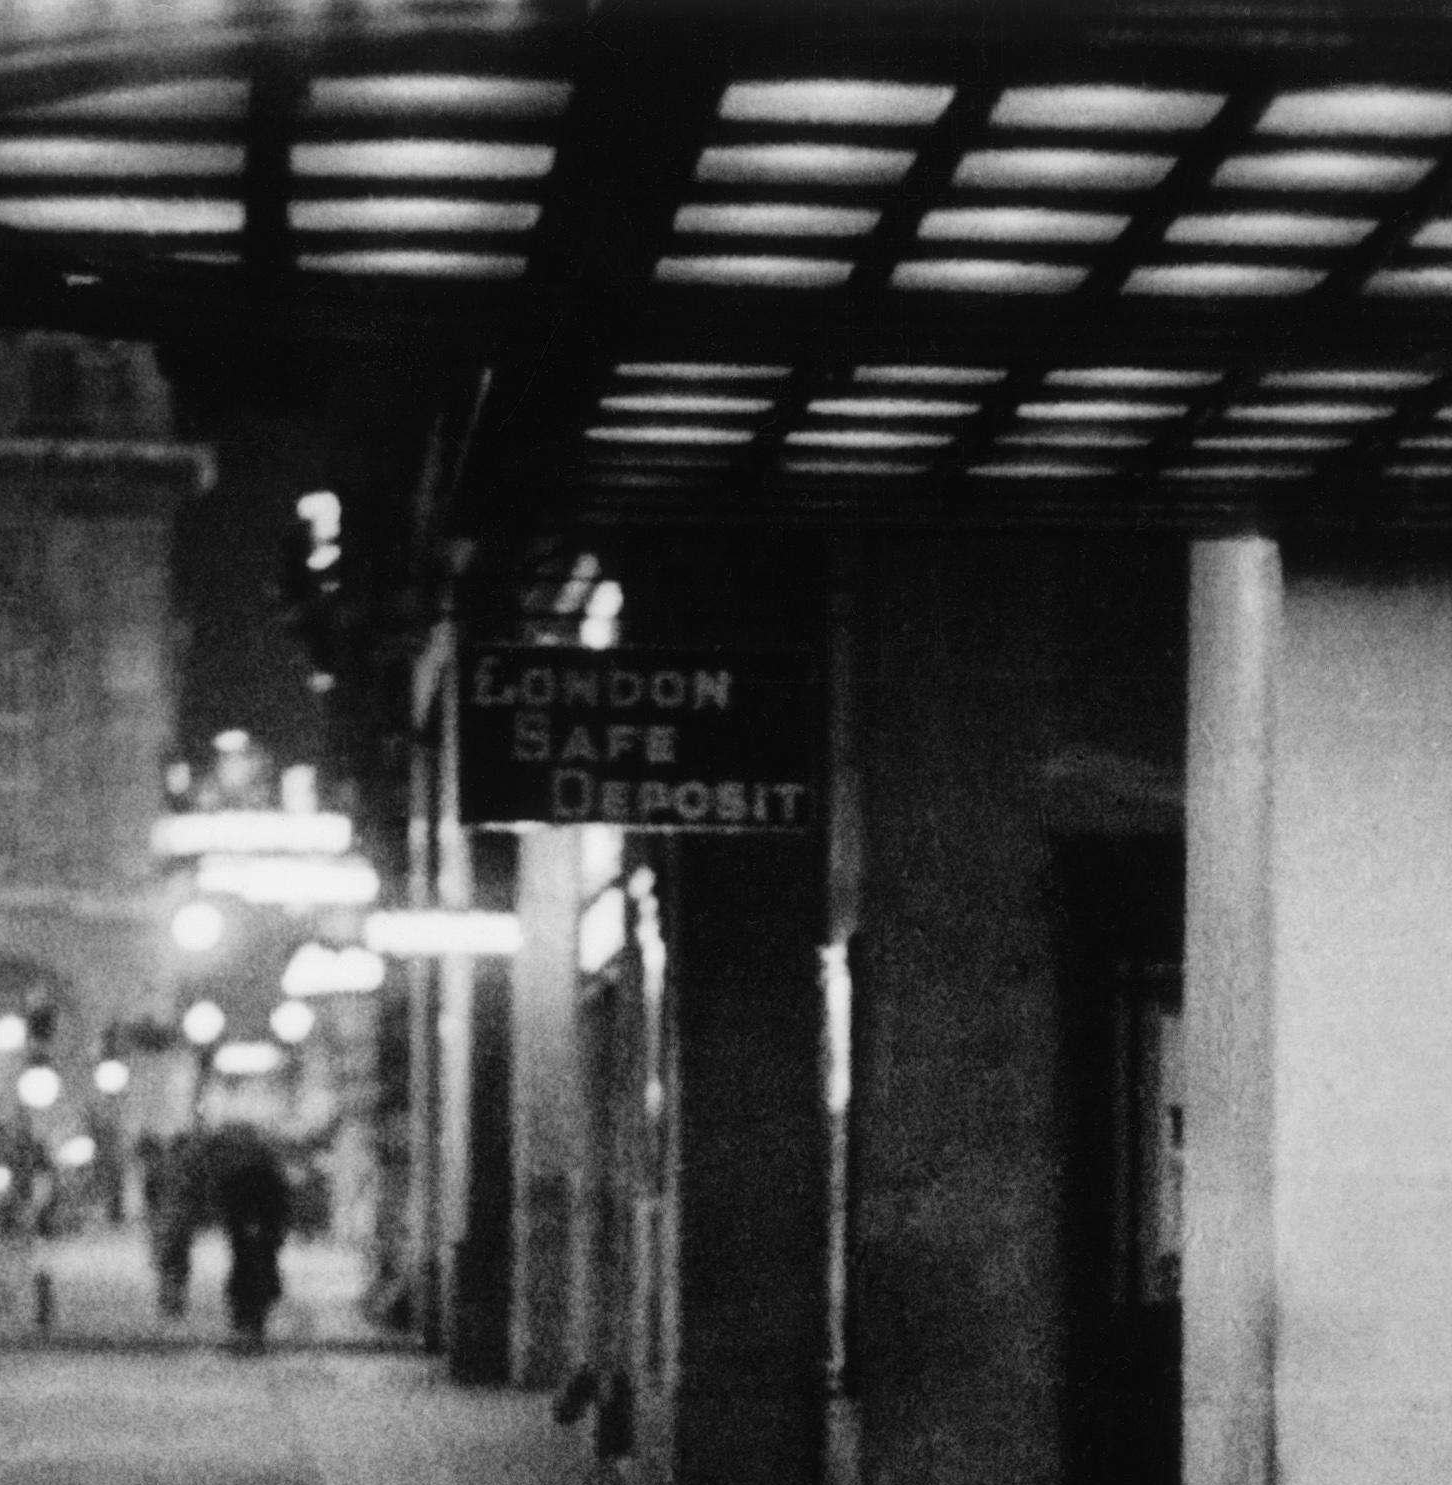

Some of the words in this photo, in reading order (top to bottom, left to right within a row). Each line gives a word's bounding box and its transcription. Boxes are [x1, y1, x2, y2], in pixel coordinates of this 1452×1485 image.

[474, 656, 732, 709] LONDON
[513, 711, 677, 763] SAFE
[553, 768, 805, 821] DEPOSIT
